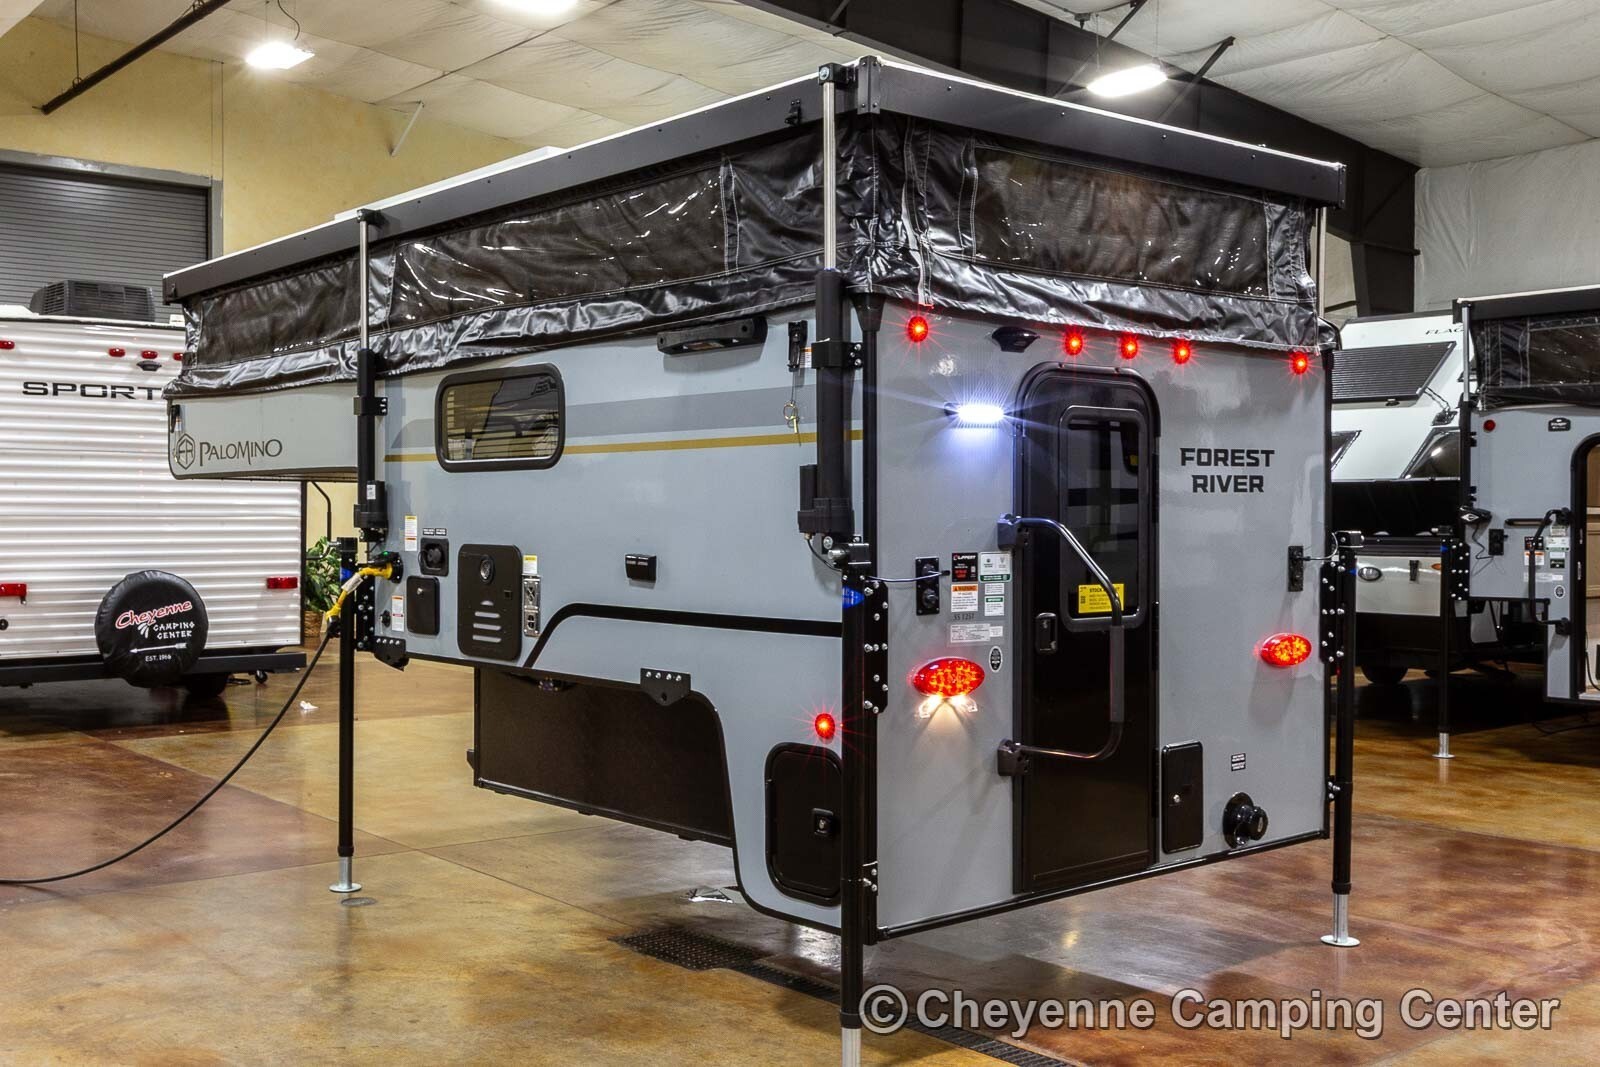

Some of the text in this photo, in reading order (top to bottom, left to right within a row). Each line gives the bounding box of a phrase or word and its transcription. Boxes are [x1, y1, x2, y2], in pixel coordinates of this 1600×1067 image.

[22, 381, 162, 400] SPORT
[1180, 447, 1275, 467] FOREST
[1191, 474, 1264, 493] RIVER
[115, 600, 193, 629] Cheyenne
[153, 621, 195, 632] CAMPING
[157, 630, 192, 640] CENTER
